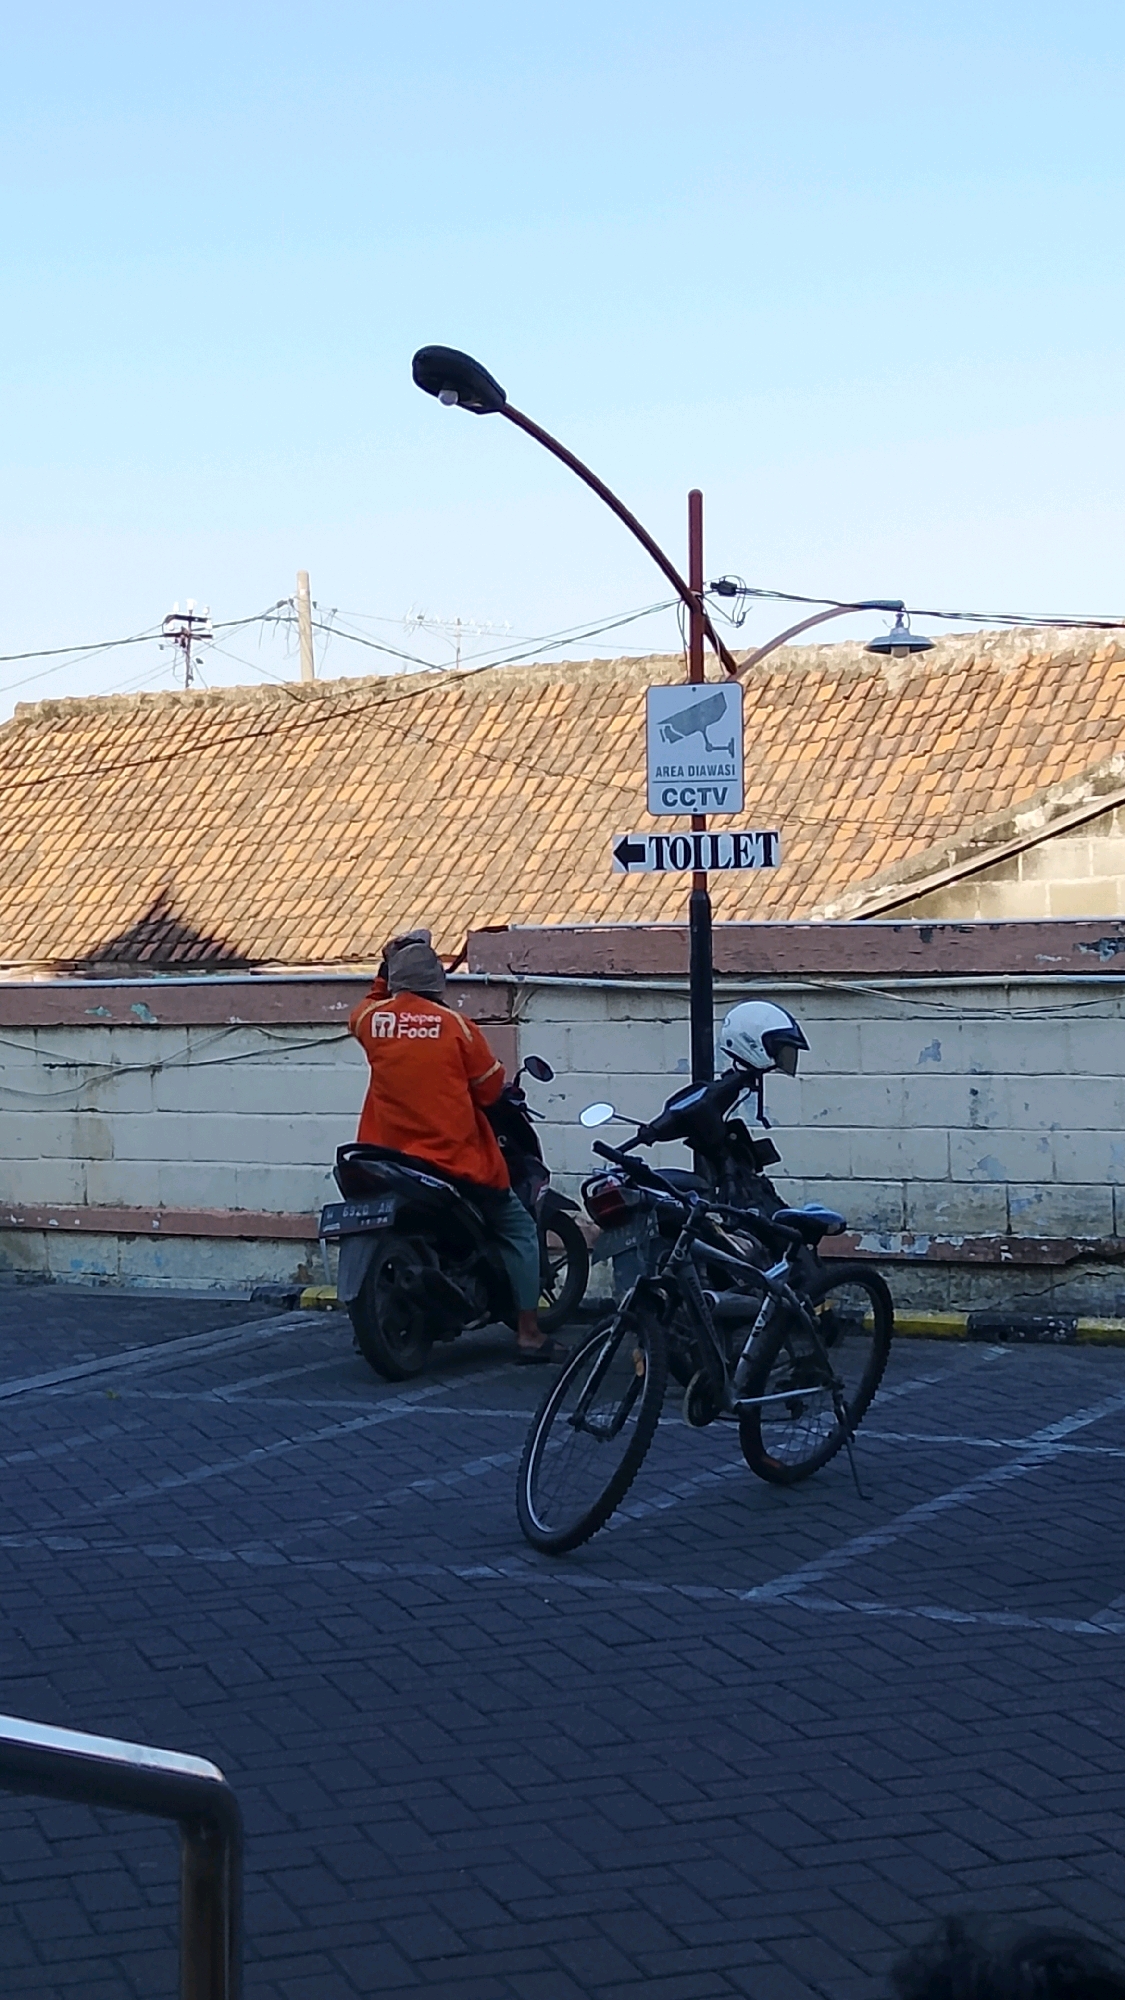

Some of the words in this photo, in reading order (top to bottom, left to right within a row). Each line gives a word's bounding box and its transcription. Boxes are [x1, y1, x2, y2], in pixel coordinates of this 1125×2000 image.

[655, 766, 685, 778] AREA
[688, 764, 736, 777] DIAWASI
[661, 787, 728, 807] CCTV
[649, 832, 778, 870] TOILET
[399, 1012, 442, 1025] Shopee
[397, 1024, 441, 1039] Food
